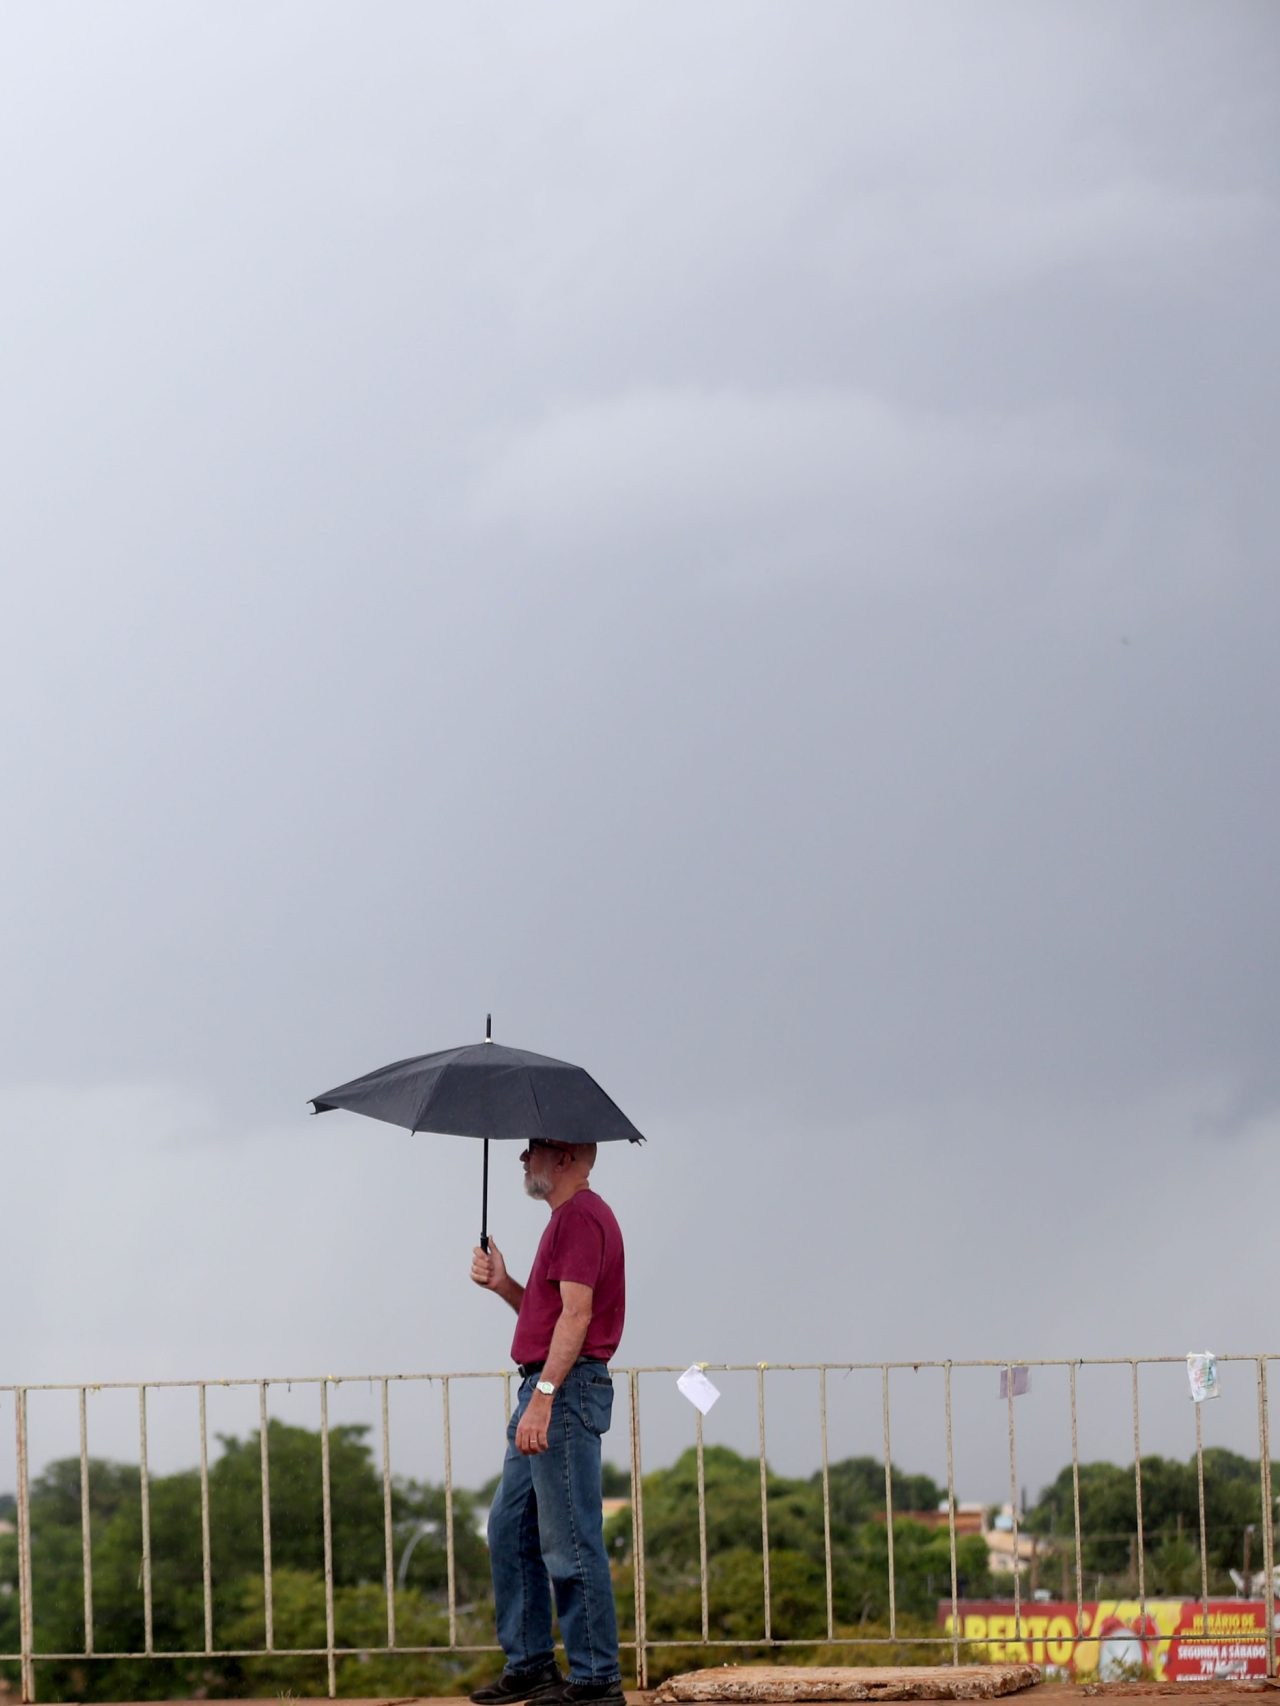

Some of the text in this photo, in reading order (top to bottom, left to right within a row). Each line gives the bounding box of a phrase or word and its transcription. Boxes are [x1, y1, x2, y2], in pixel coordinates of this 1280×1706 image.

[1242, 1613, 1256, 1627] DE
[1178, 1643, 1266, 1660] SEGUNDA A SÁBADO
